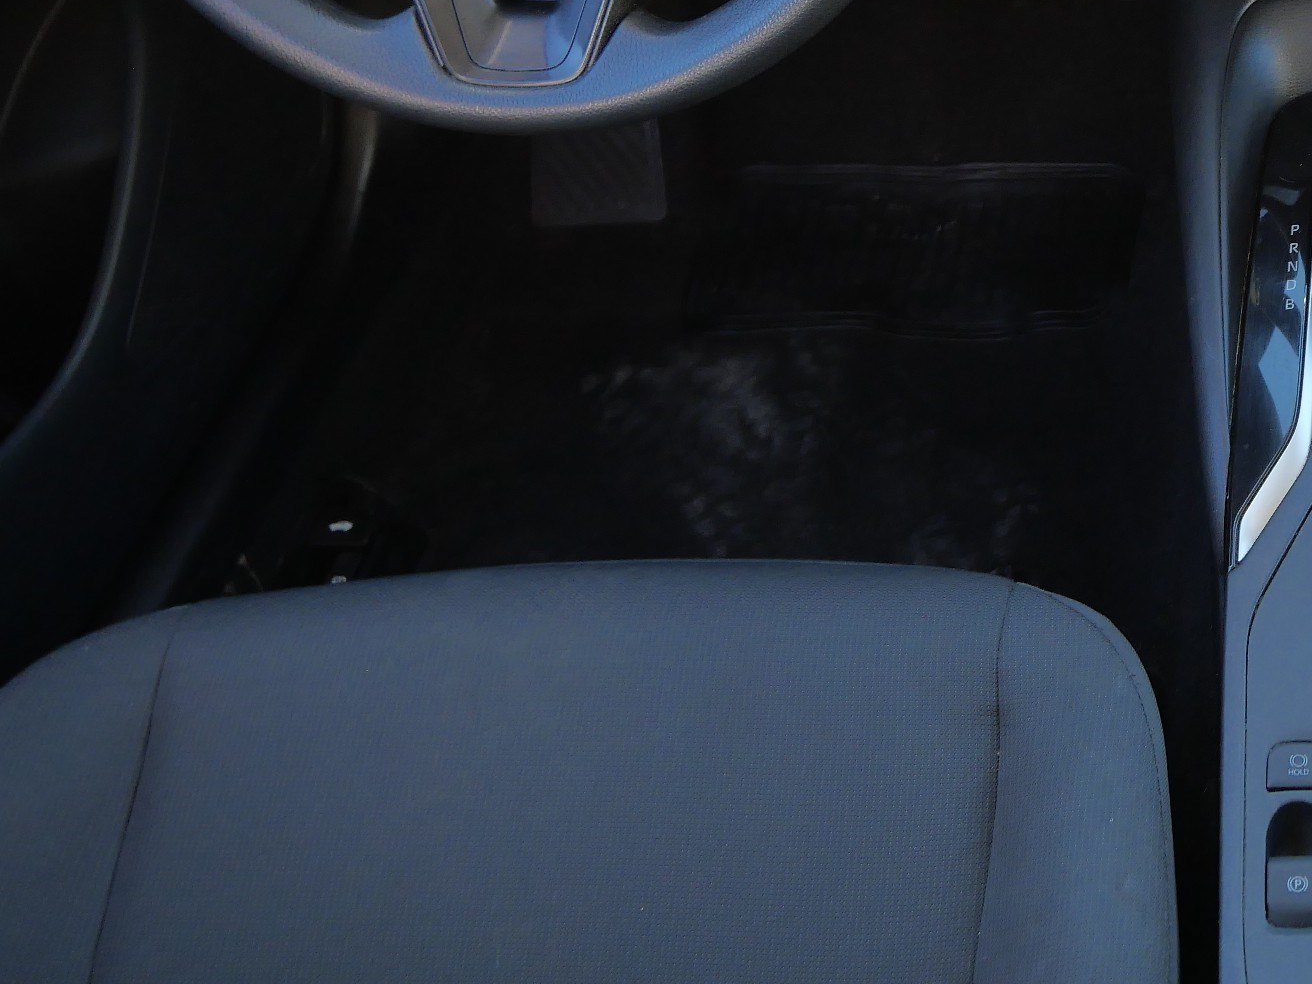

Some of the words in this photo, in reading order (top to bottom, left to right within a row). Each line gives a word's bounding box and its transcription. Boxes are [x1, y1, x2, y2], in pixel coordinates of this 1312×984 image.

[1290, 224, 1300, 236] P
[1289, 242, 1299, 254] R
[1287, 260, 1298, 272] N
[1286, 279, 1296, 291] D
[1285, 298, 1295, 310] B
[1288, 768, 1310, 776] HOLD
